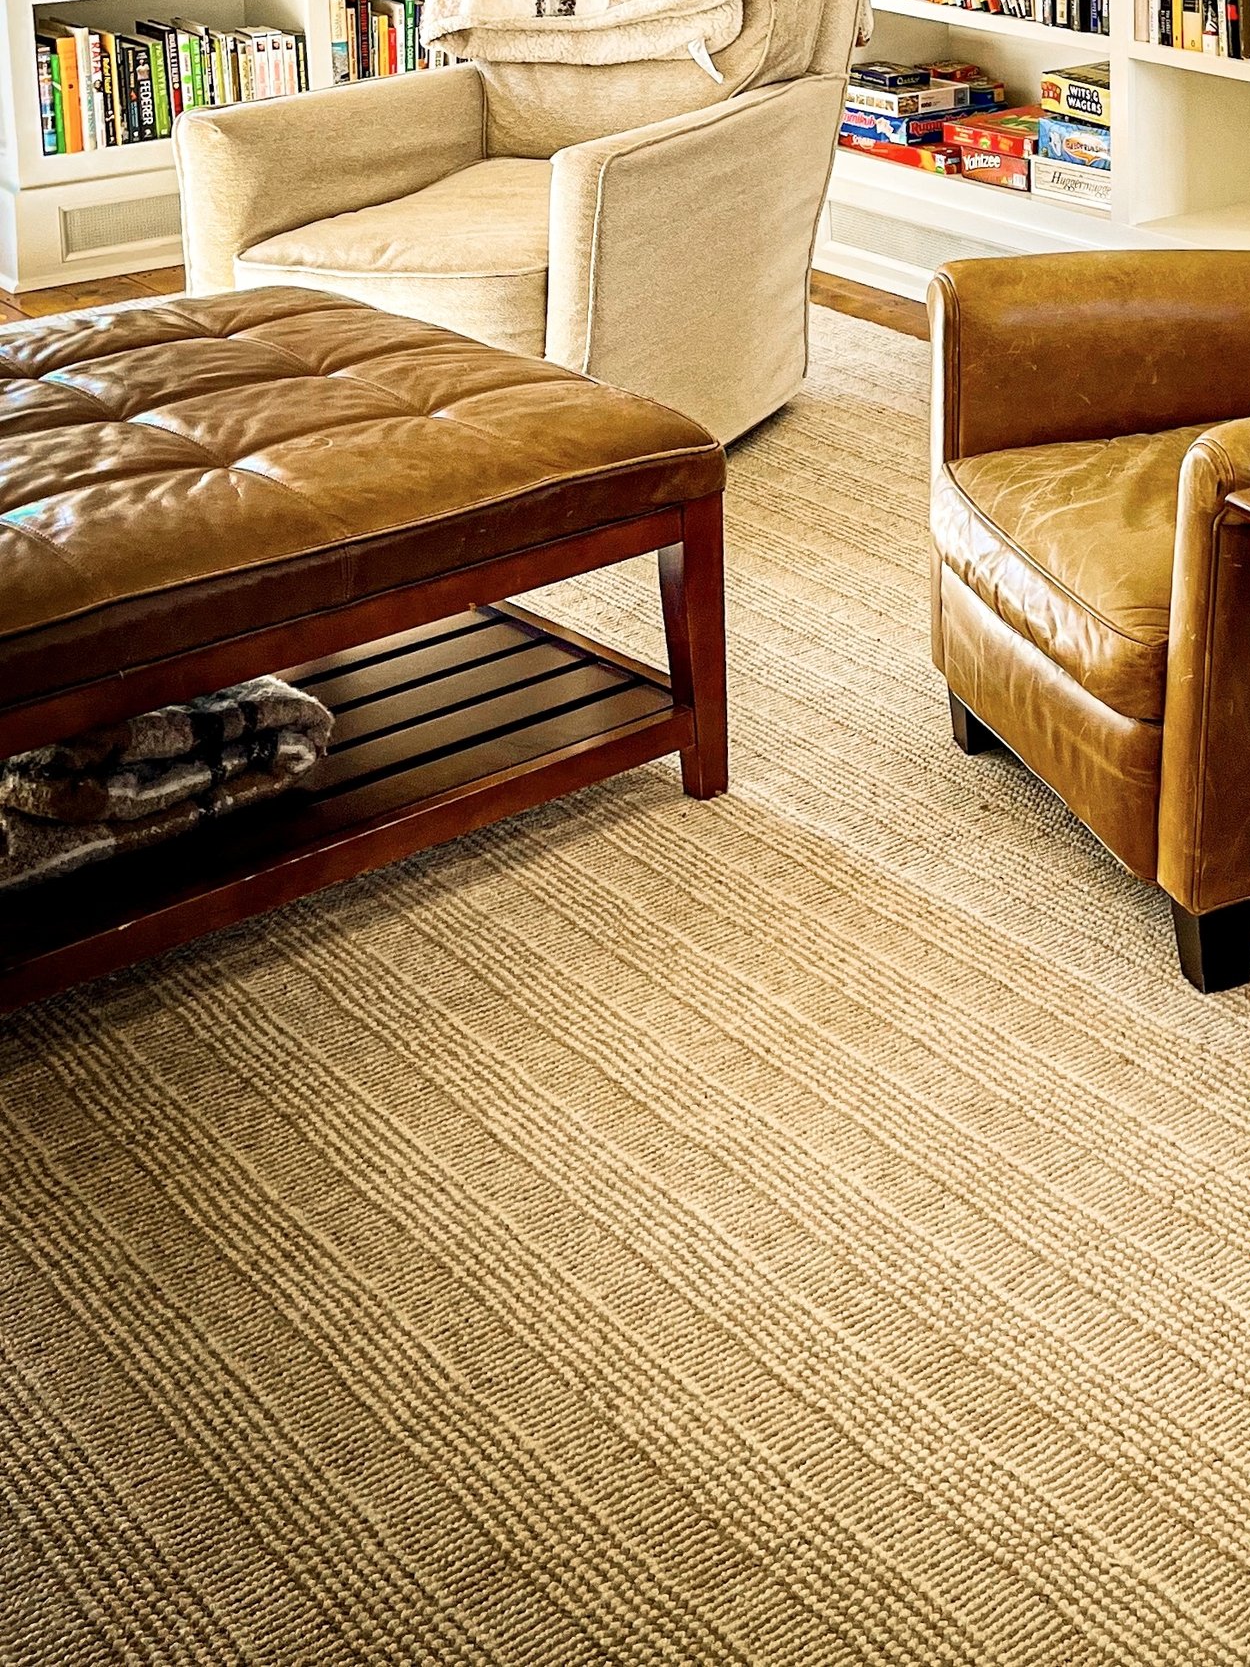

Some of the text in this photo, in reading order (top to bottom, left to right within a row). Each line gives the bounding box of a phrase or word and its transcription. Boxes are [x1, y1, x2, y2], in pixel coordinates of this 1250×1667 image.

[90, 41, 102, 74] RAFA
[1069, 85, 1087, 97] WITS
[140, 80, 153, 125] FEDERER
[1067, 96, 1102, 114] WAGERS
[963, 156, 1001, 171] Yahtzee
